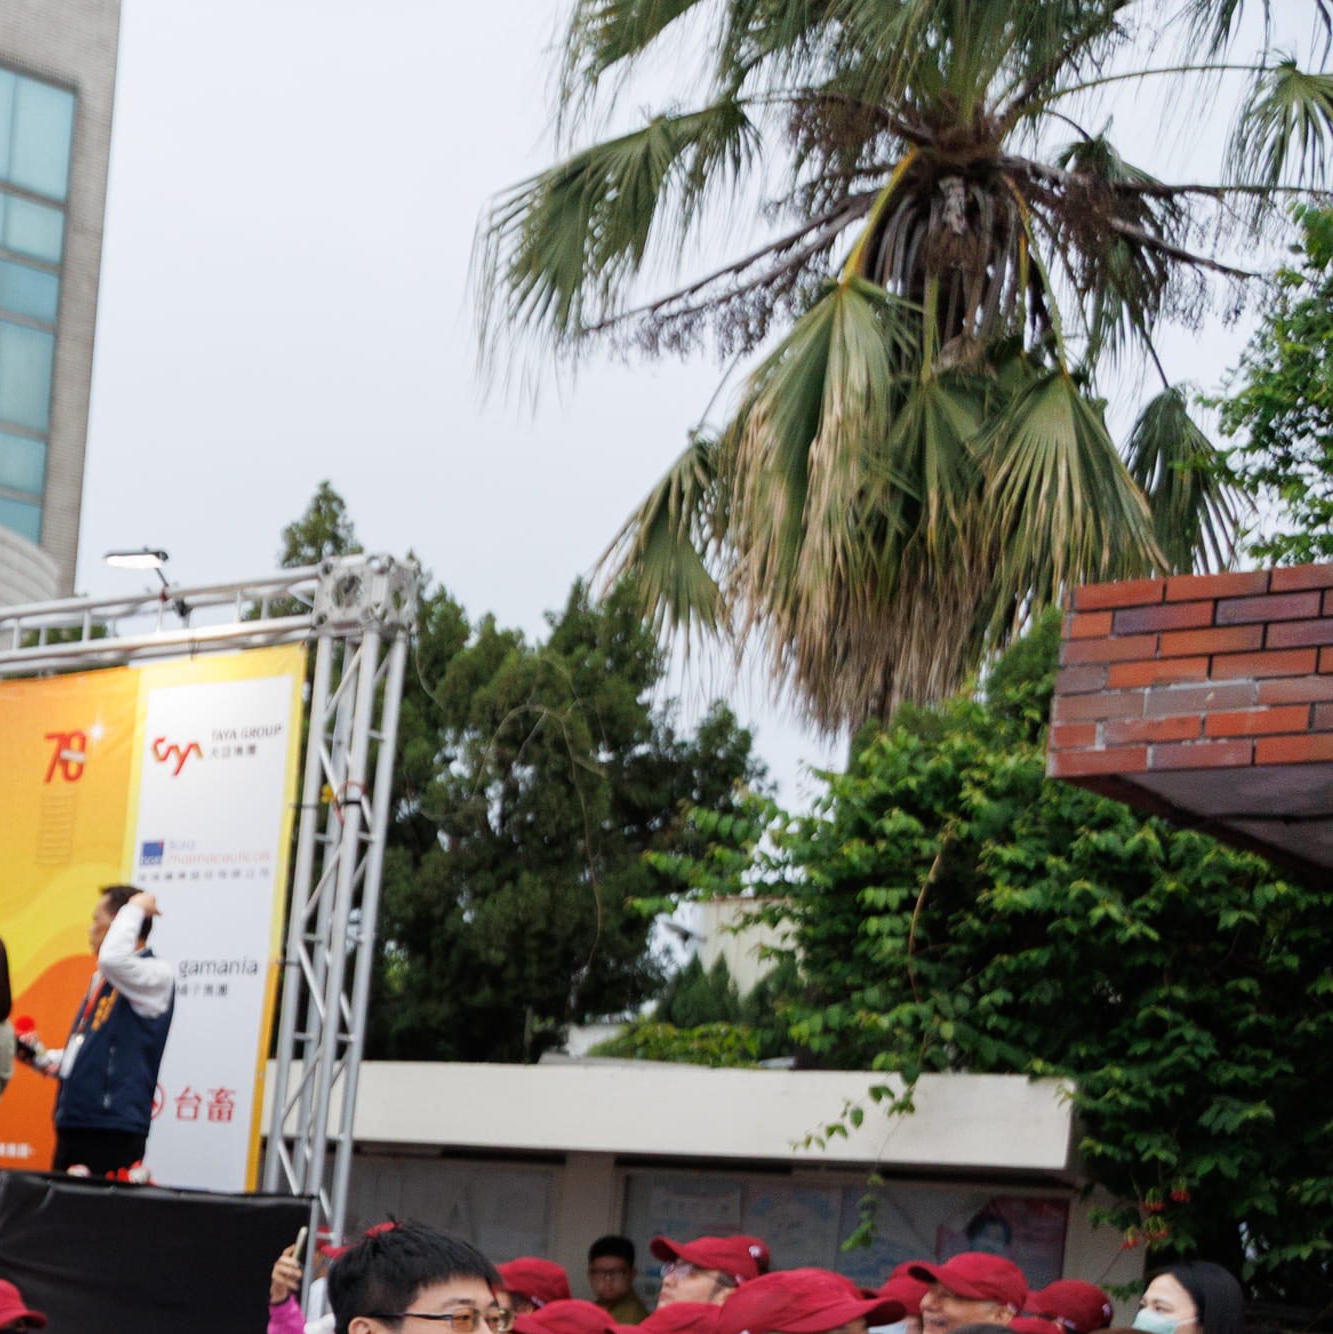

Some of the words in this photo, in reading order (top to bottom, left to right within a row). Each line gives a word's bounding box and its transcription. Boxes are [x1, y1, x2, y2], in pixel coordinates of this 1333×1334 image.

[212, 728, 240, 742] TAYA
[241, 724, 282, 740] GROUP
[179, 955, 259, 978] gamania
[175, 1085, 236, 1123] 台畜
